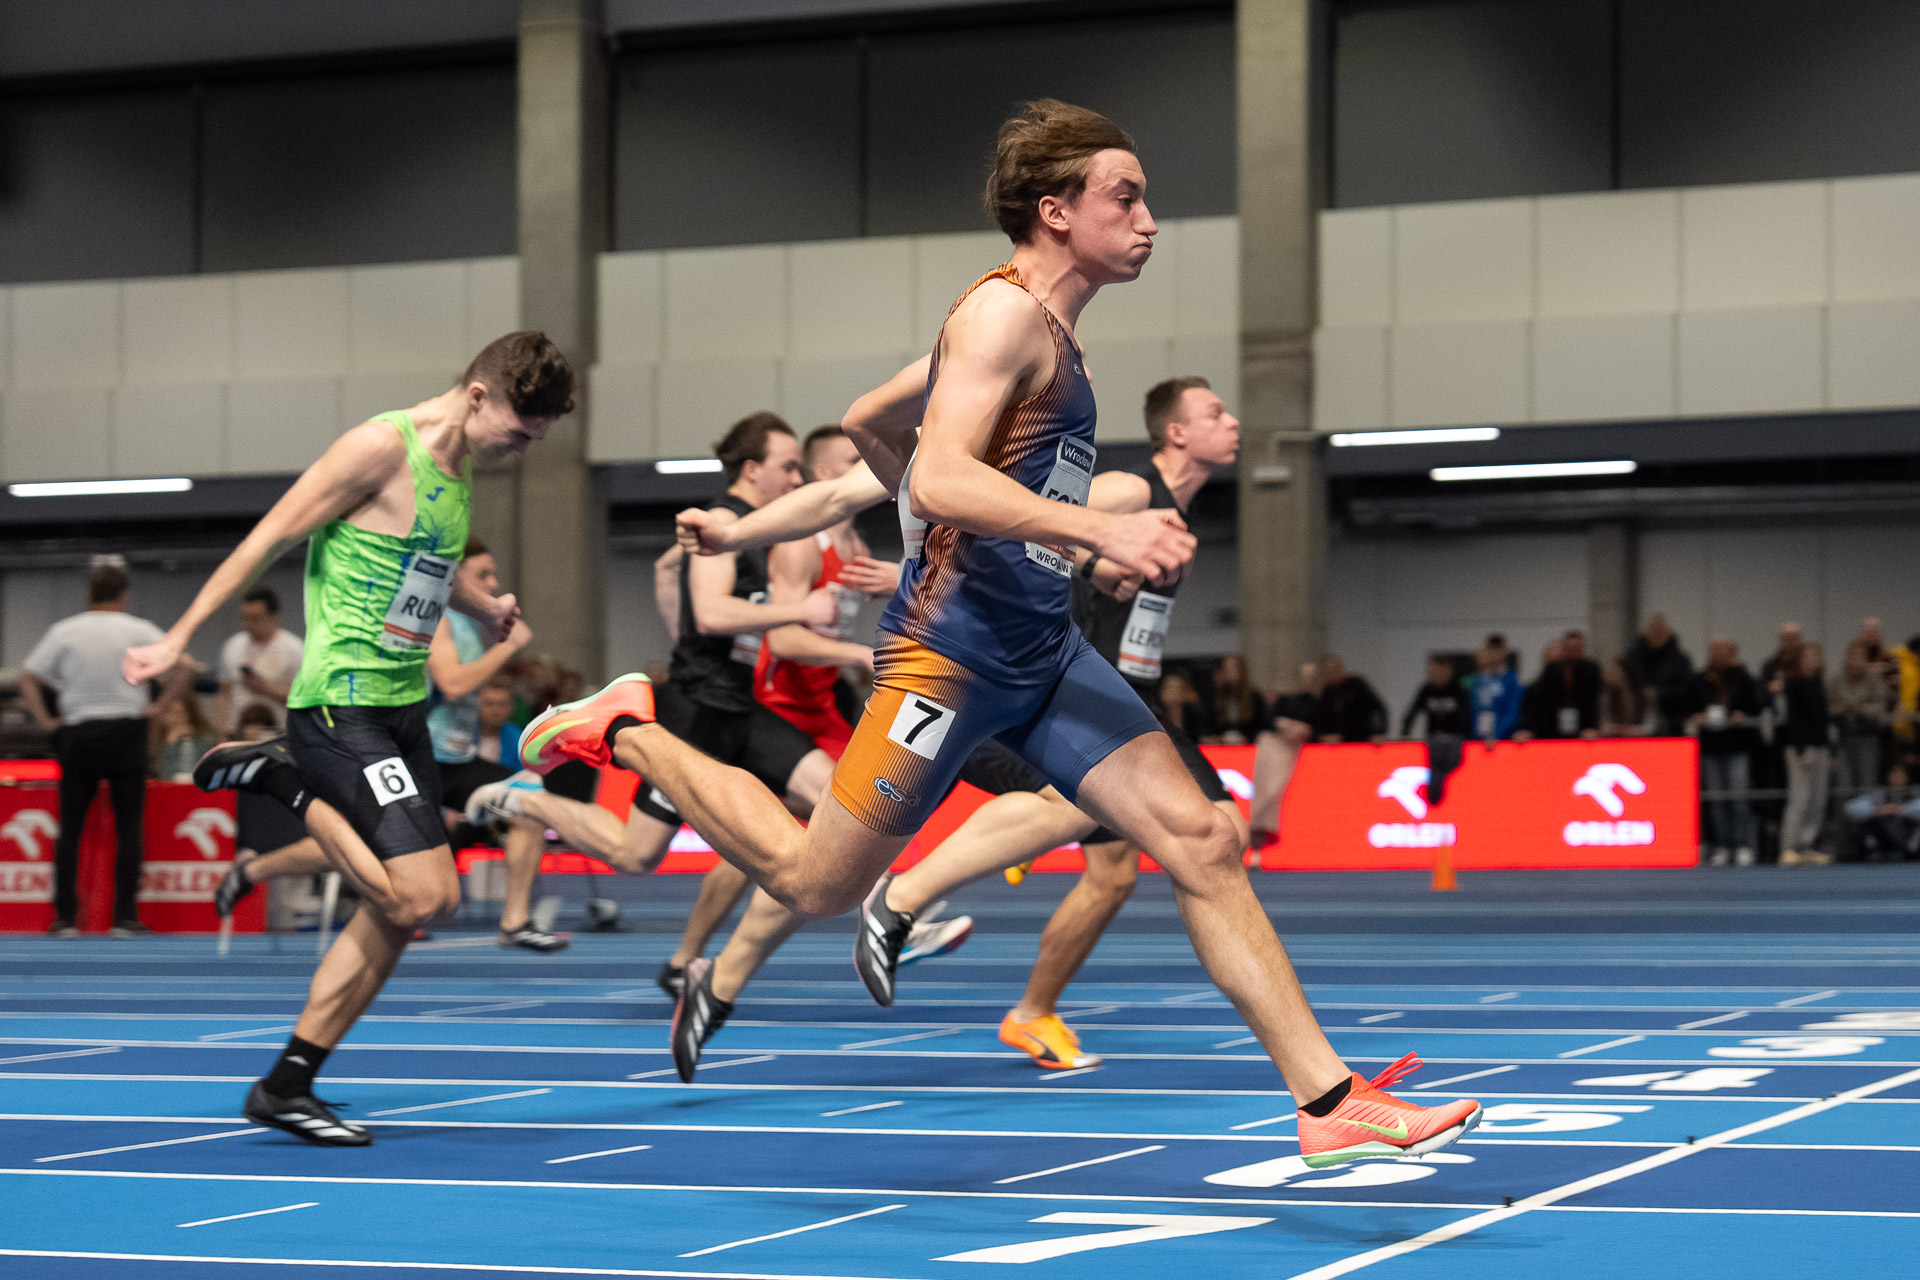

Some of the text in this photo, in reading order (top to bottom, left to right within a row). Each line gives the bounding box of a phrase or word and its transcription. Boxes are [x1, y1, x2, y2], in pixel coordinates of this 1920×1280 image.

[904, 699, 944, 746] 7
[379, 763, 405, 795] 6
[1706, 1035, 1886, 1059] 3
[1571, 1066, 1777, 1092] 4
[1477, 1103, 1655, 1133] 5
[1202, 1151, 1476, 1189] 6
[930, 1211, 1277, 1265] 7
